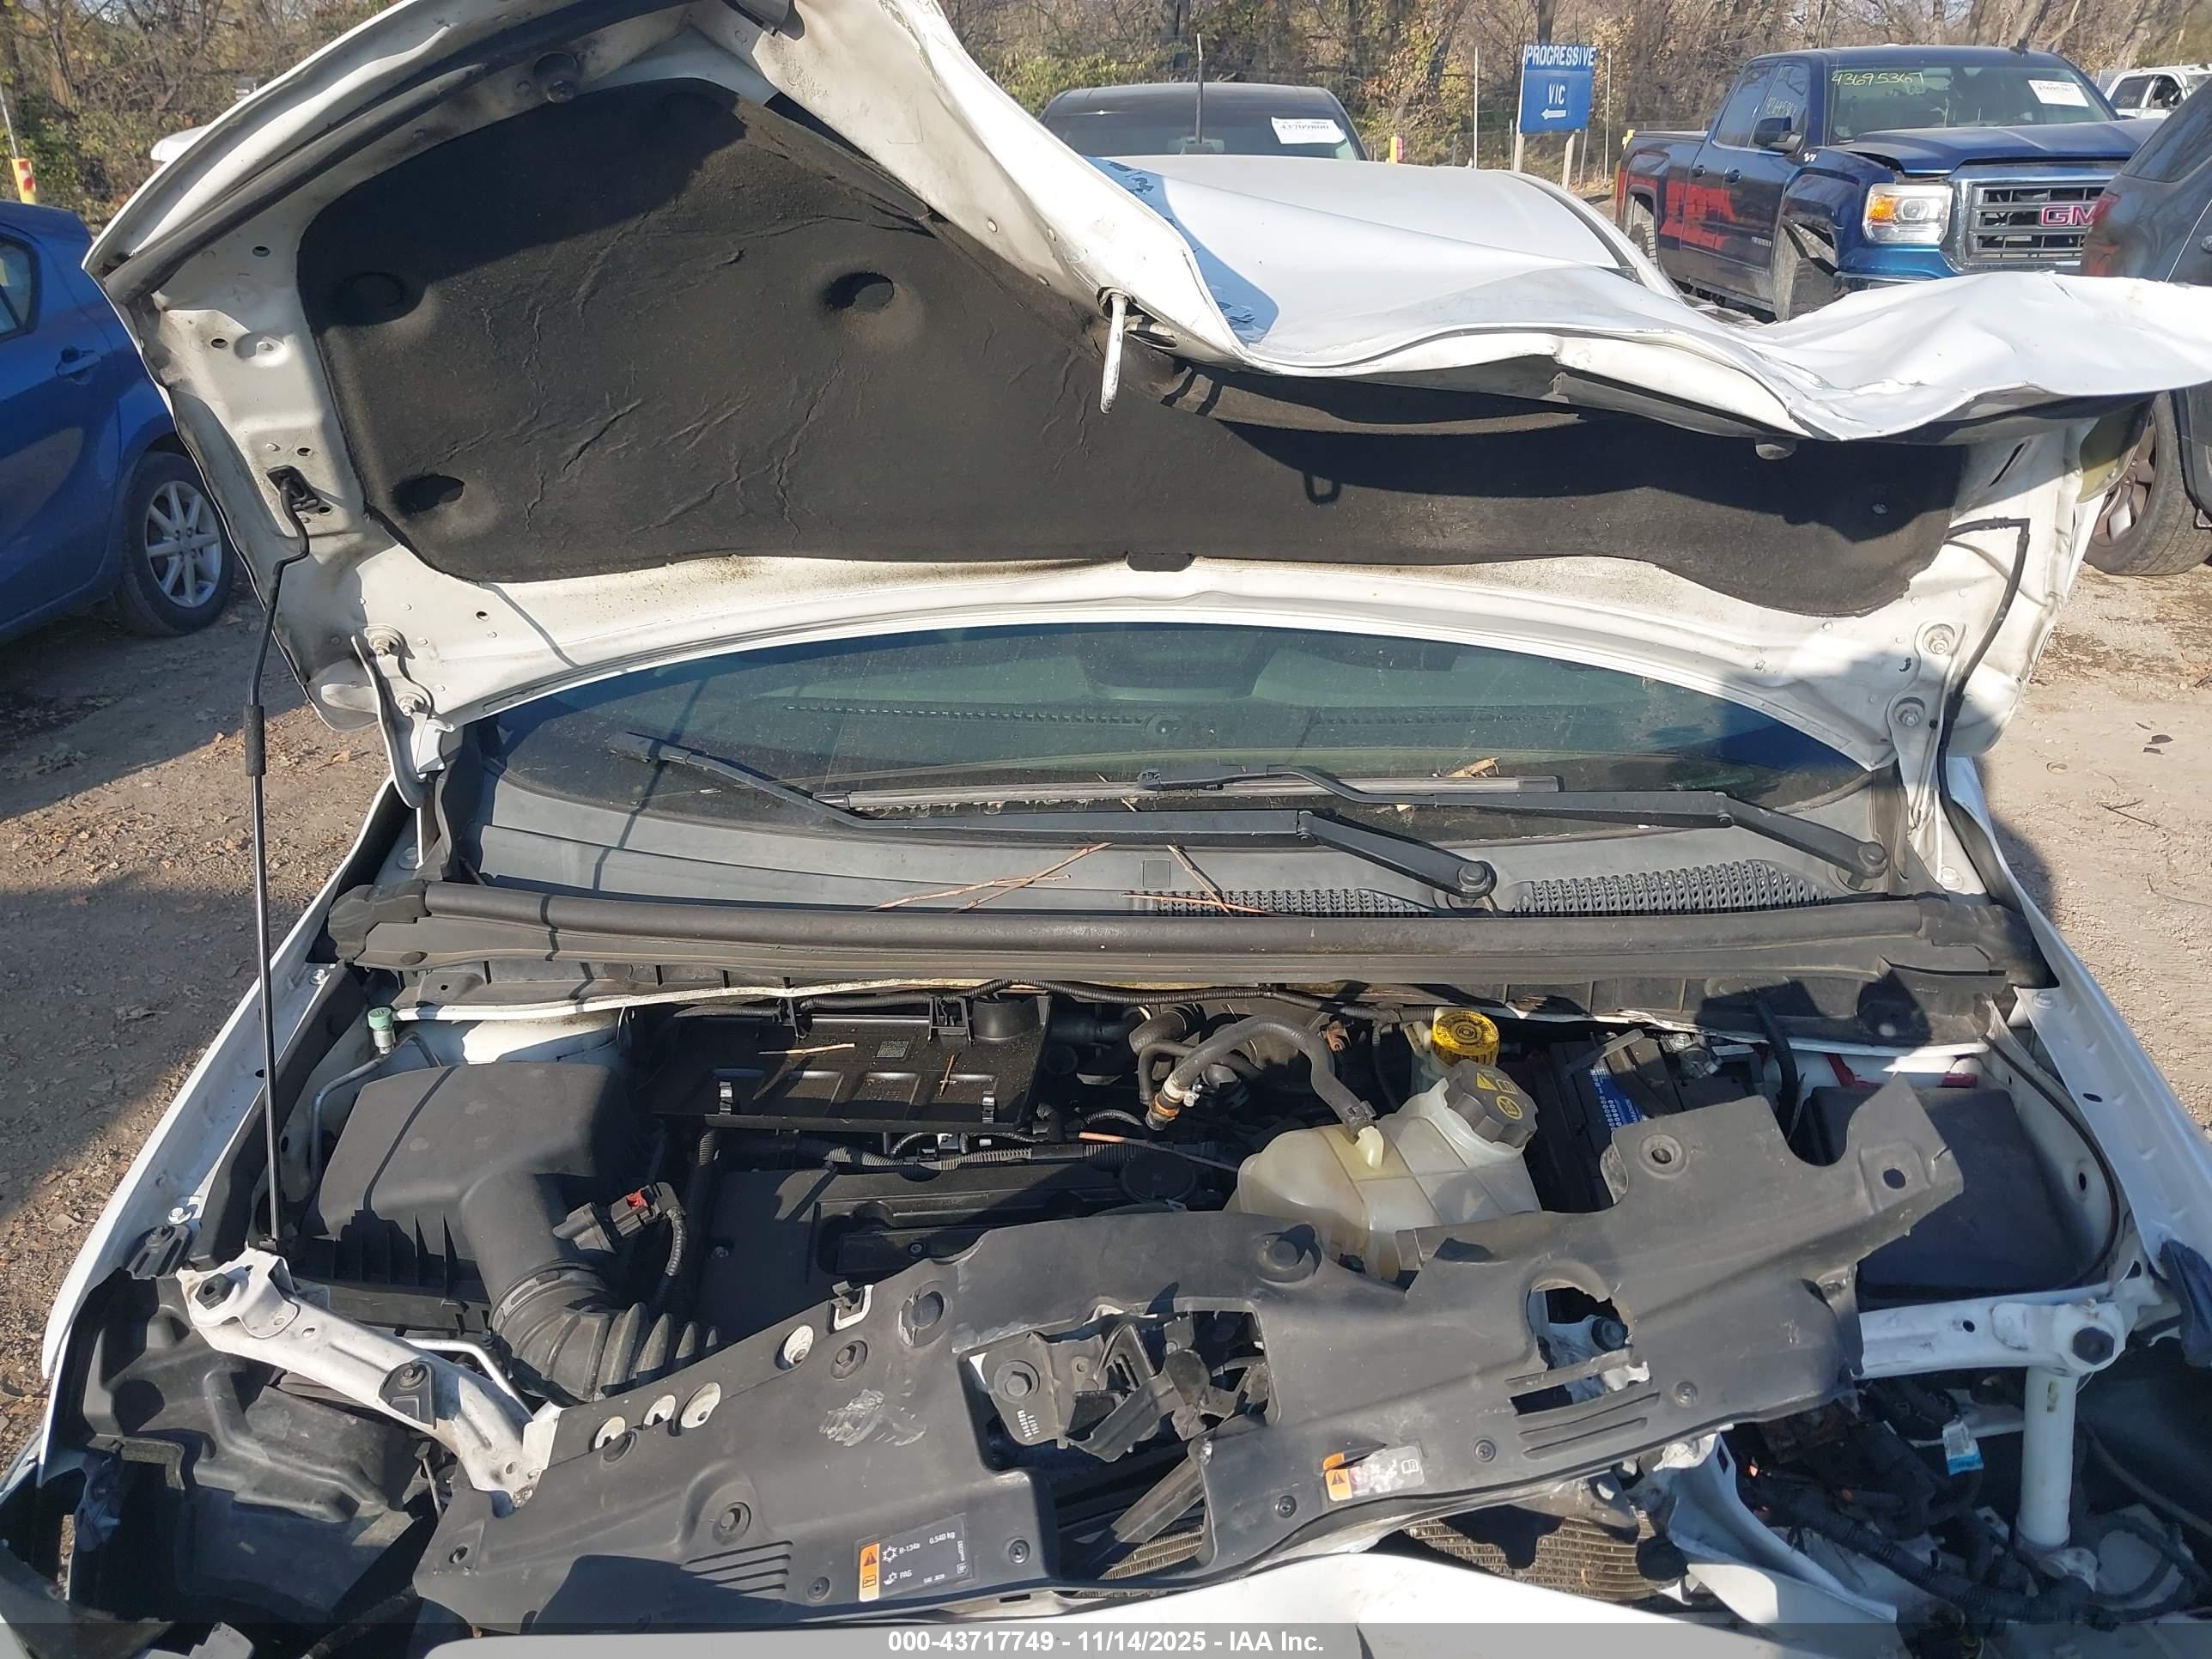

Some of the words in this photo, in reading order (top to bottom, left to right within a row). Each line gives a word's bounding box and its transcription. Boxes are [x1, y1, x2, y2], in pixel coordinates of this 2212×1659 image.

[1526, 45, 1597, 66] PROGRESSIVE
[1831, 72, 1924, 86] 43695367
[1548, 82, 1565, 105] VIC
[2041, 205, 2096, 227] GM
